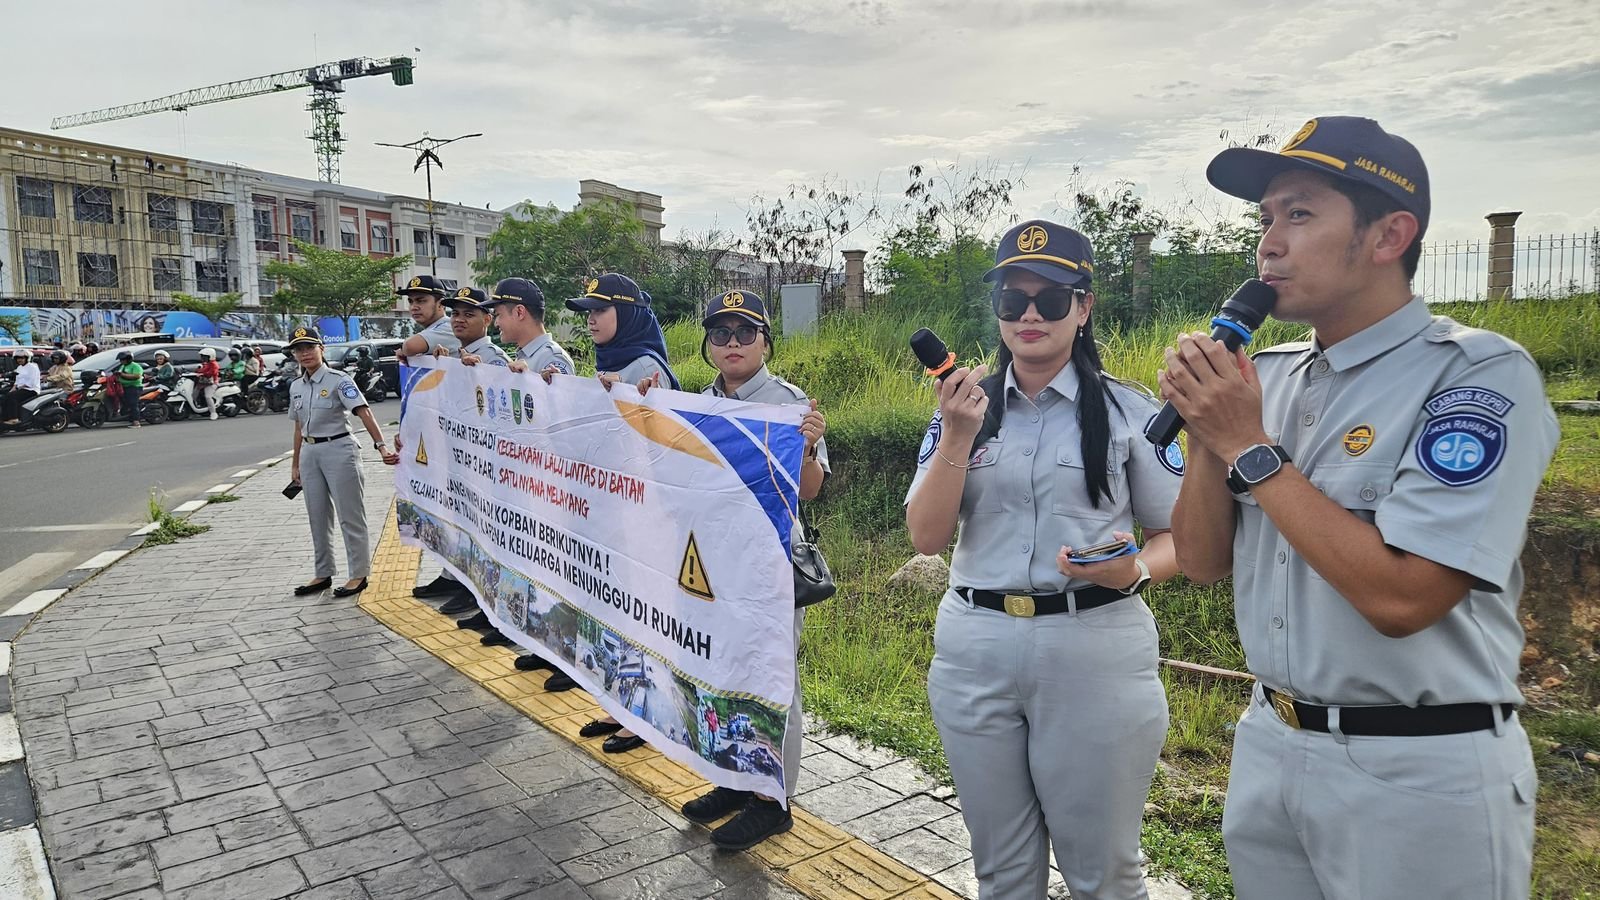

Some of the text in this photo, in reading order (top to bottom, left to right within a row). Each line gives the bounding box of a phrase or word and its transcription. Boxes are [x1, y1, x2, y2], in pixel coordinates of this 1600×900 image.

[1354, 157, 1416, 194] JASA RAHARJA
[1428, 420, 1498, 440] JASA RAHARJA
[1431, 391, 1506, 411] CABANG KEPRI
[452, 421, 467, 440] HARI
[468, 426, 497, 451] TERJADI
[497, 438, 542, 468] KECELAKAAN
[544, 453, 563, 477] LALU
[565, 461, 596, 488] LINTAS
[598, 468, 608, 493] DI
[609, 472, 645, 504] BATAM
[473, 456, 477, 471] 3
[499, 468, 518, 491] SATU
[519, 474, 545, 502] NYAWA
[546, 484, 590, 519] MELAYANG
[410, 479, 438, 502] SELAMAT
[508, 534, 561, 579] KELUARGA
[563, 560, 631, 614] MENUNGGU
[633, 600, 648, 625] DI
[651, 607, 712, 660] RUMAH
[495, 504, 536, 538] KORBAN
[538, 524, 602, 573] BERIKUTNYA
